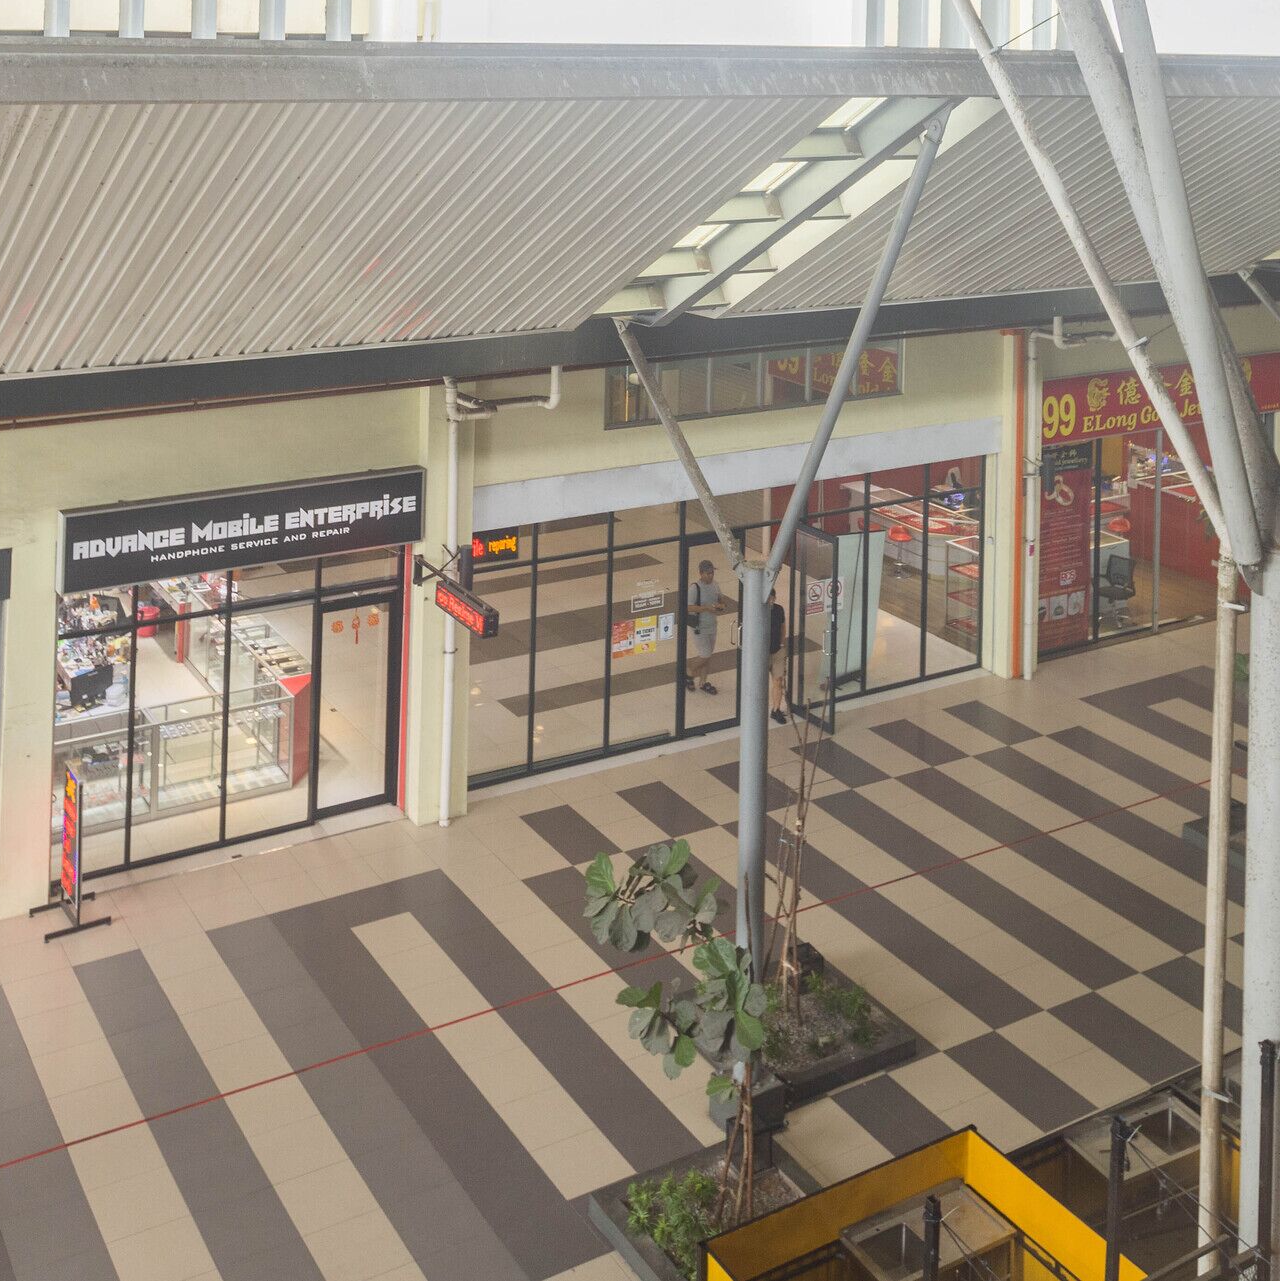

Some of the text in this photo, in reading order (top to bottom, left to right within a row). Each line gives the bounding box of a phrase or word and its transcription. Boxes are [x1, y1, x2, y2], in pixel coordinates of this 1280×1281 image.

[1042, 394, 1076, 439] 99
[73, 528, 185, 560] ADVANCE
[150, 526, 350, 563] HANDPHONE SERVICE AND REPAIR
